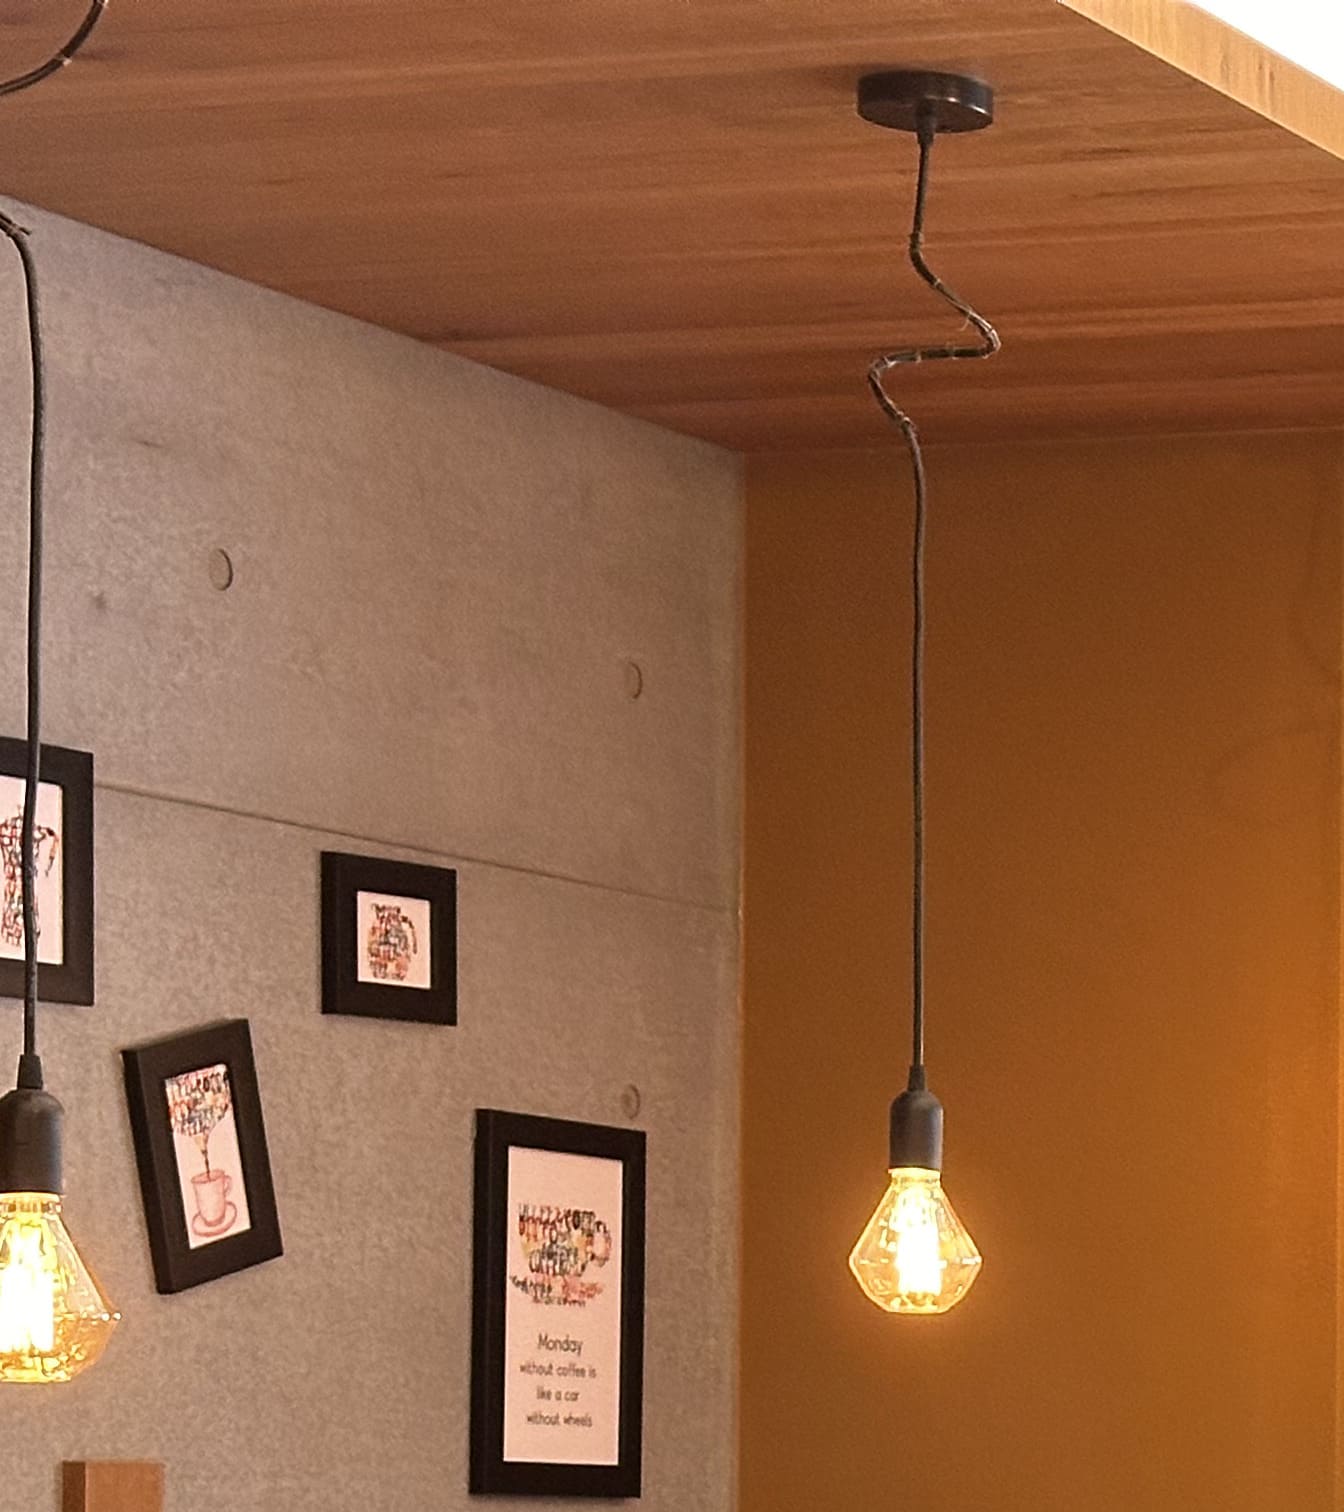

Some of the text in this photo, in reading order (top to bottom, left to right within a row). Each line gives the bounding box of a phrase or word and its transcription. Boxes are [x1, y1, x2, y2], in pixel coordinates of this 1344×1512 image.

[537, 1332, 583, 1356] Monday
[520, 1361, 597, 1378] without coffee is
[536, 1384, 552, 1400] like
[564, 1391, 580, 1401] car
[527, 1411, 592, 1427] without wheels
